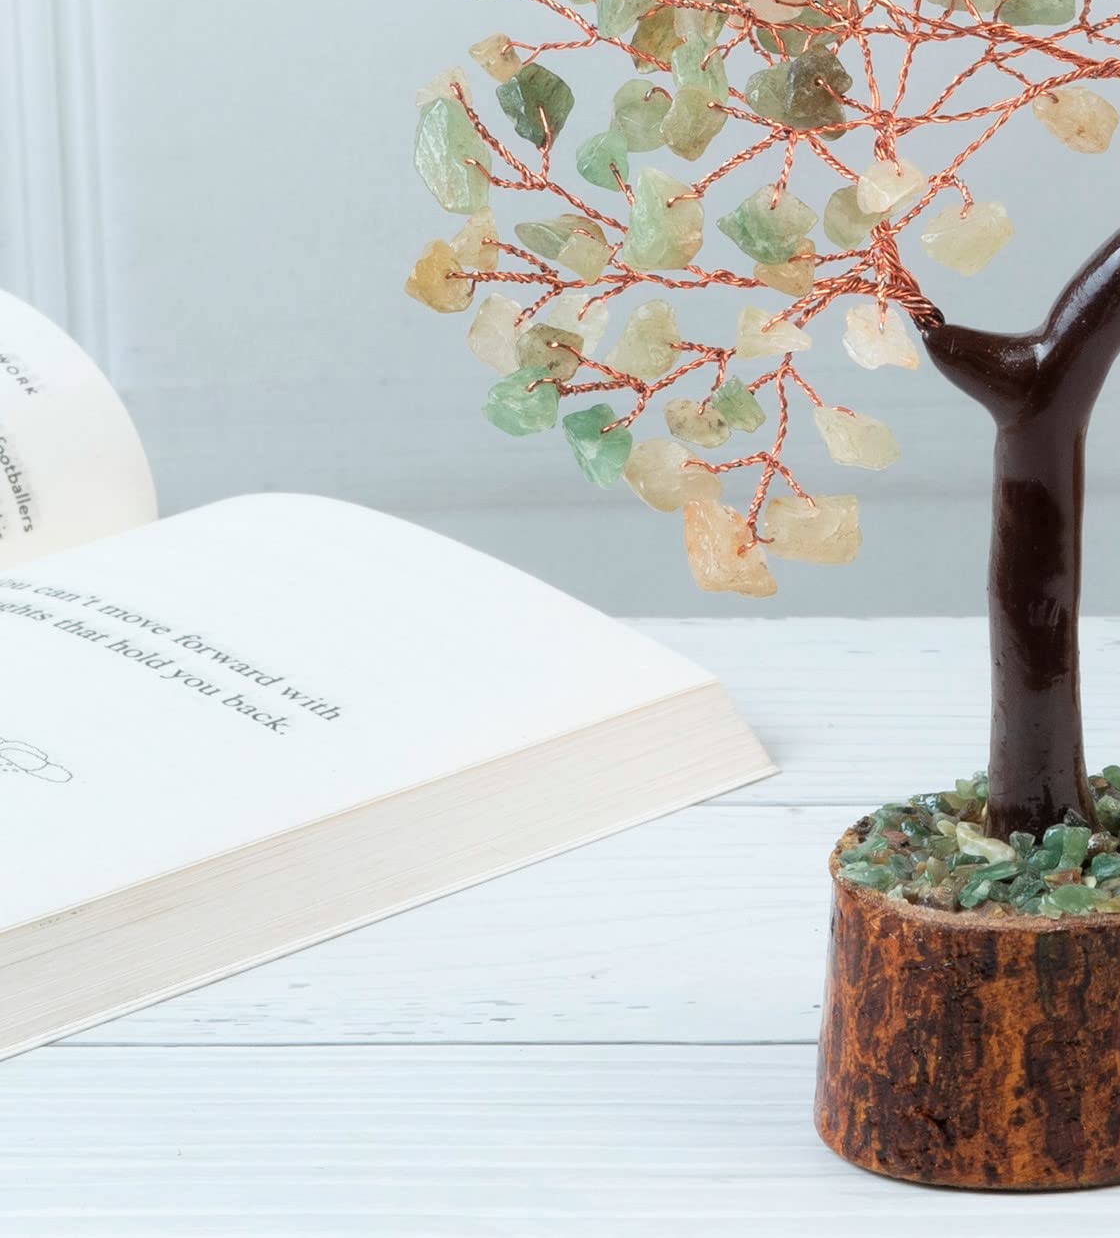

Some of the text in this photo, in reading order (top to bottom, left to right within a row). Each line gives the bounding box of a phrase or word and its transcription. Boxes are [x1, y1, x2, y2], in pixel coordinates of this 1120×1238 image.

[33, 586, 100, 607] can't
[98, 604, 171, 636] move
[172, 634, 285, 687] forward
[281, 686, 342, 721] with
[53, 618, 110, 643] that
[104, 638, 175, 670] hold
[159, 668, 222, 697] you
[221, 693, 291, 736] back.
